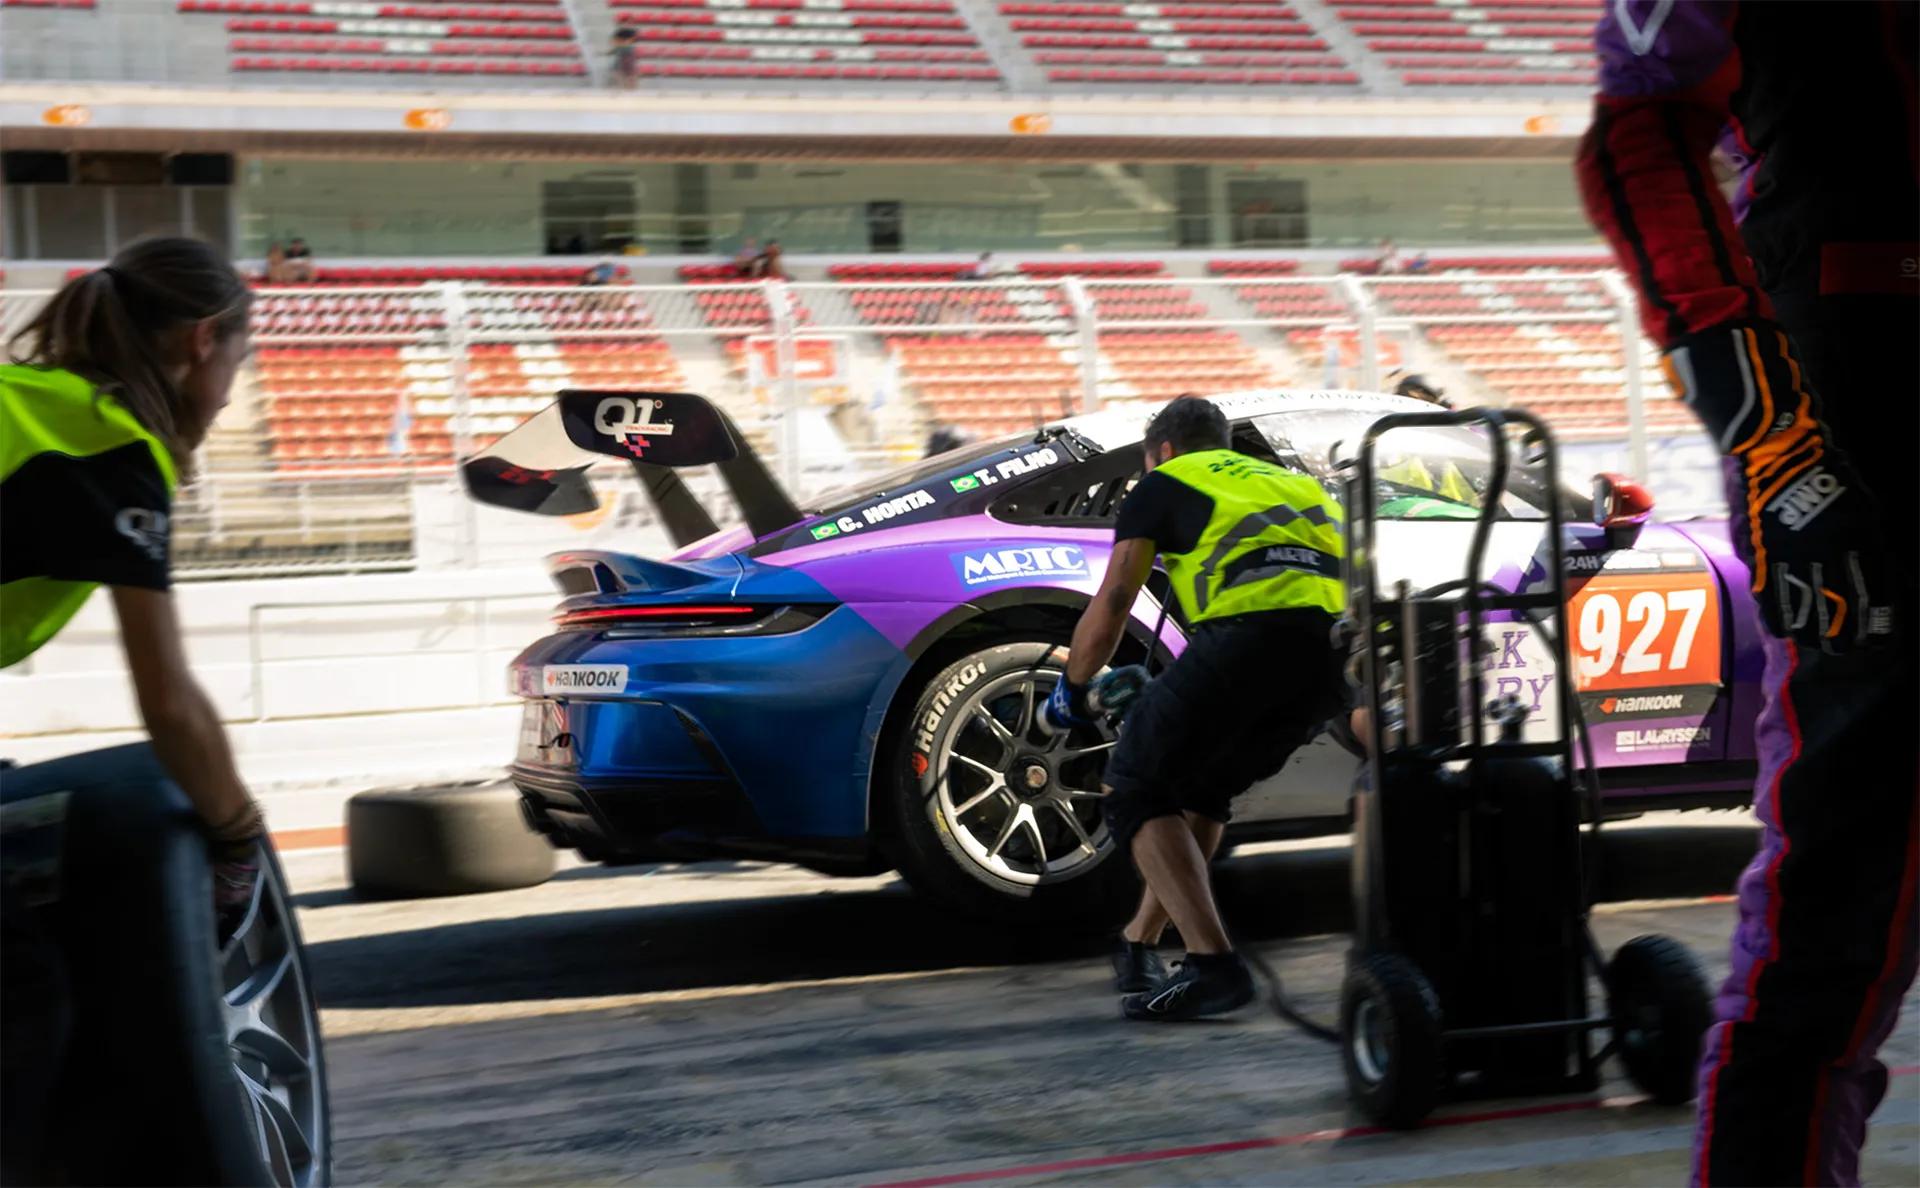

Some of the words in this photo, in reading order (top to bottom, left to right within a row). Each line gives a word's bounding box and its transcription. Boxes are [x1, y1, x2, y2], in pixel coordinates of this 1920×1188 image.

[973, 468, 998, 486] T.
[996, 448, 1059, 479] FILHO
[837, 516, 864, 533] C.
[862, 489, 936, 524] HORTA
[964, 546, 1084, 580] MRTC
[1562, 555, 1600, 570] 24H
[1578, 589, 1708, 679] 927
[1636, 727, 1712, 744] LAURYSSEN
